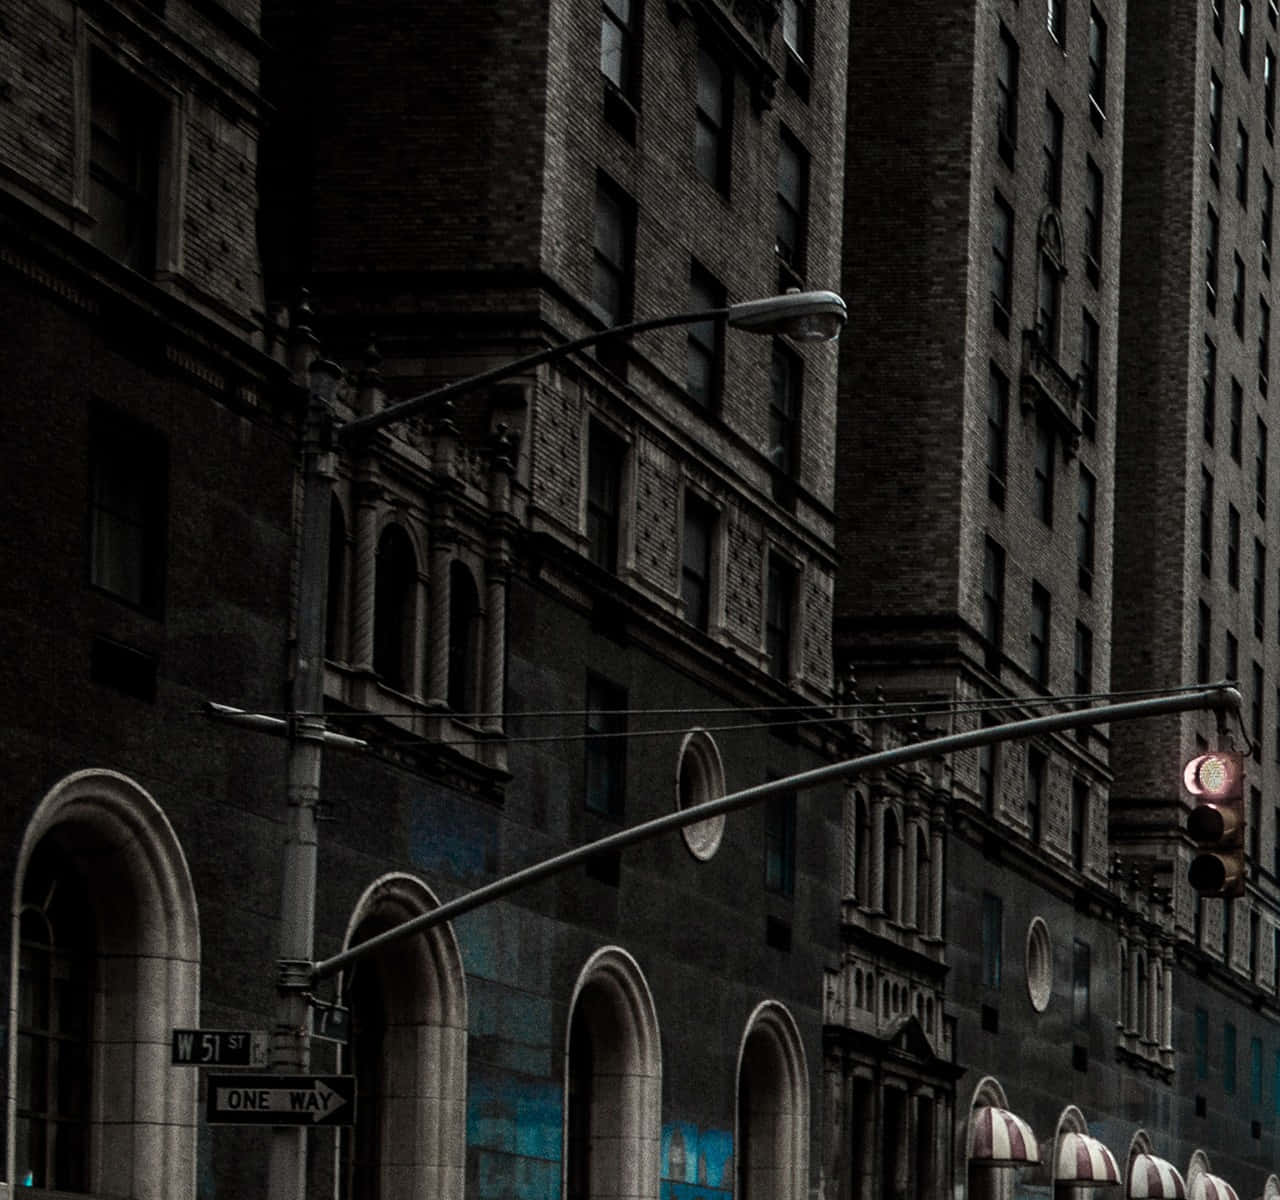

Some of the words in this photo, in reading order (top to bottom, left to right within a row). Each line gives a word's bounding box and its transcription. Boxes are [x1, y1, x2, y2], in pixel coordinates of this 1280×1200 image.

[177, 1032, 194, 1062] W
[201, 1033, 221, 1063] 51
[228, 1035, 246, 1049] ST
[228, 1090, 271, 1110] ONE
[288, 1090, 333, 1111] WAY
